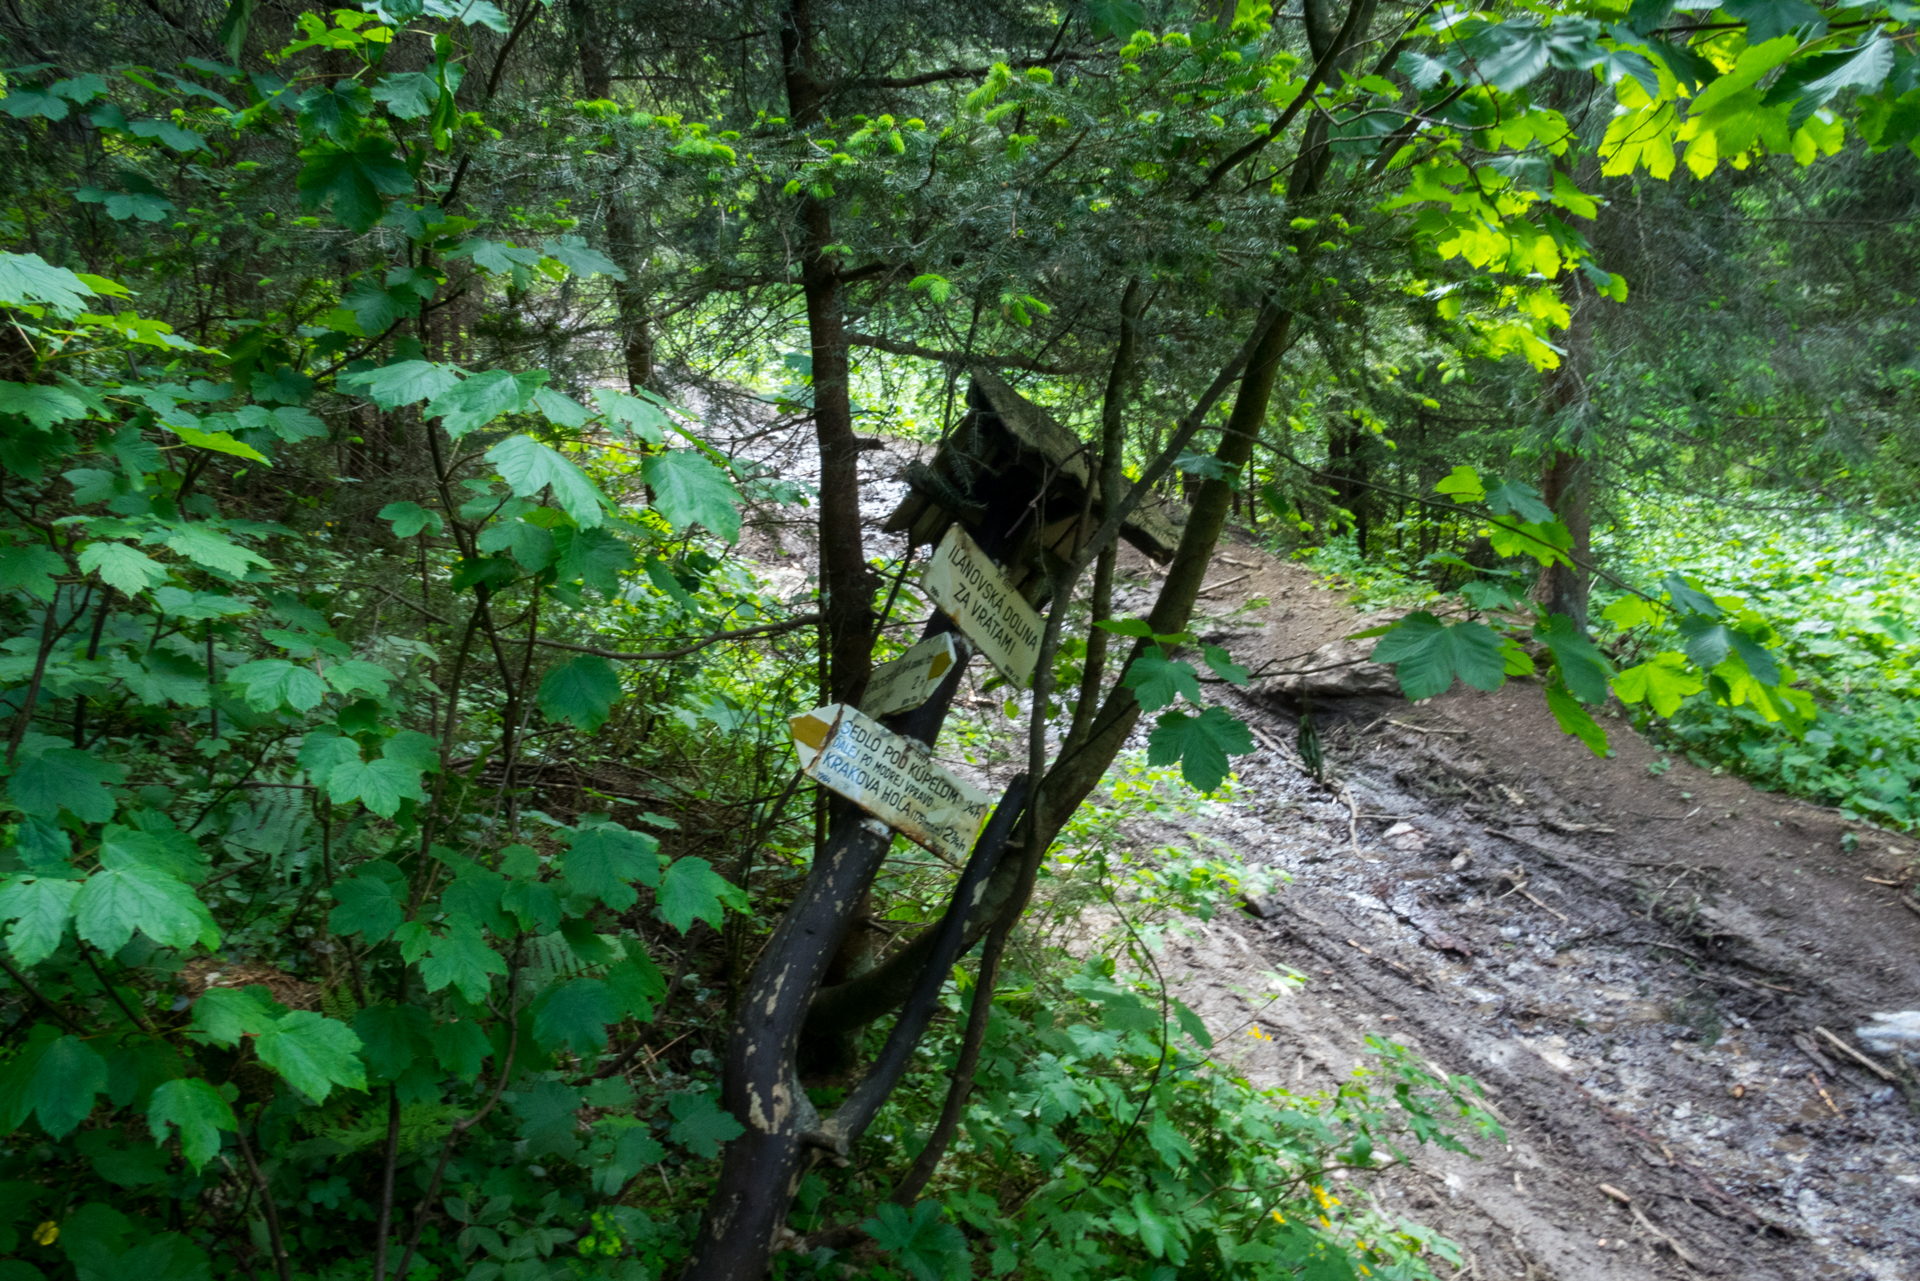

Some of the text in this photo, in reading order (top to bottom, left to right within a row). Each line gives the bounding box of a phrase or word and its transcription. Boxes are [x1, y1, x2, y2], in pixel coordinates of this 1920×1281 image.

[948, 545, 1039, 652] ILANOVSKÁ DOLINA
[953, 582, 971, 609] ZA
[971, 600, 1016, 656] VRÁTAMI
[841, 720, 881, 752] SEDLO
[882, 745, 908, 769] POD
[822, 751, 880, 795] KRAKOVA
[861, 753, 873, 767] PO
[873, 761, 905, 787] MODREJ
[904, 780, 934, 807] VPRAVO
